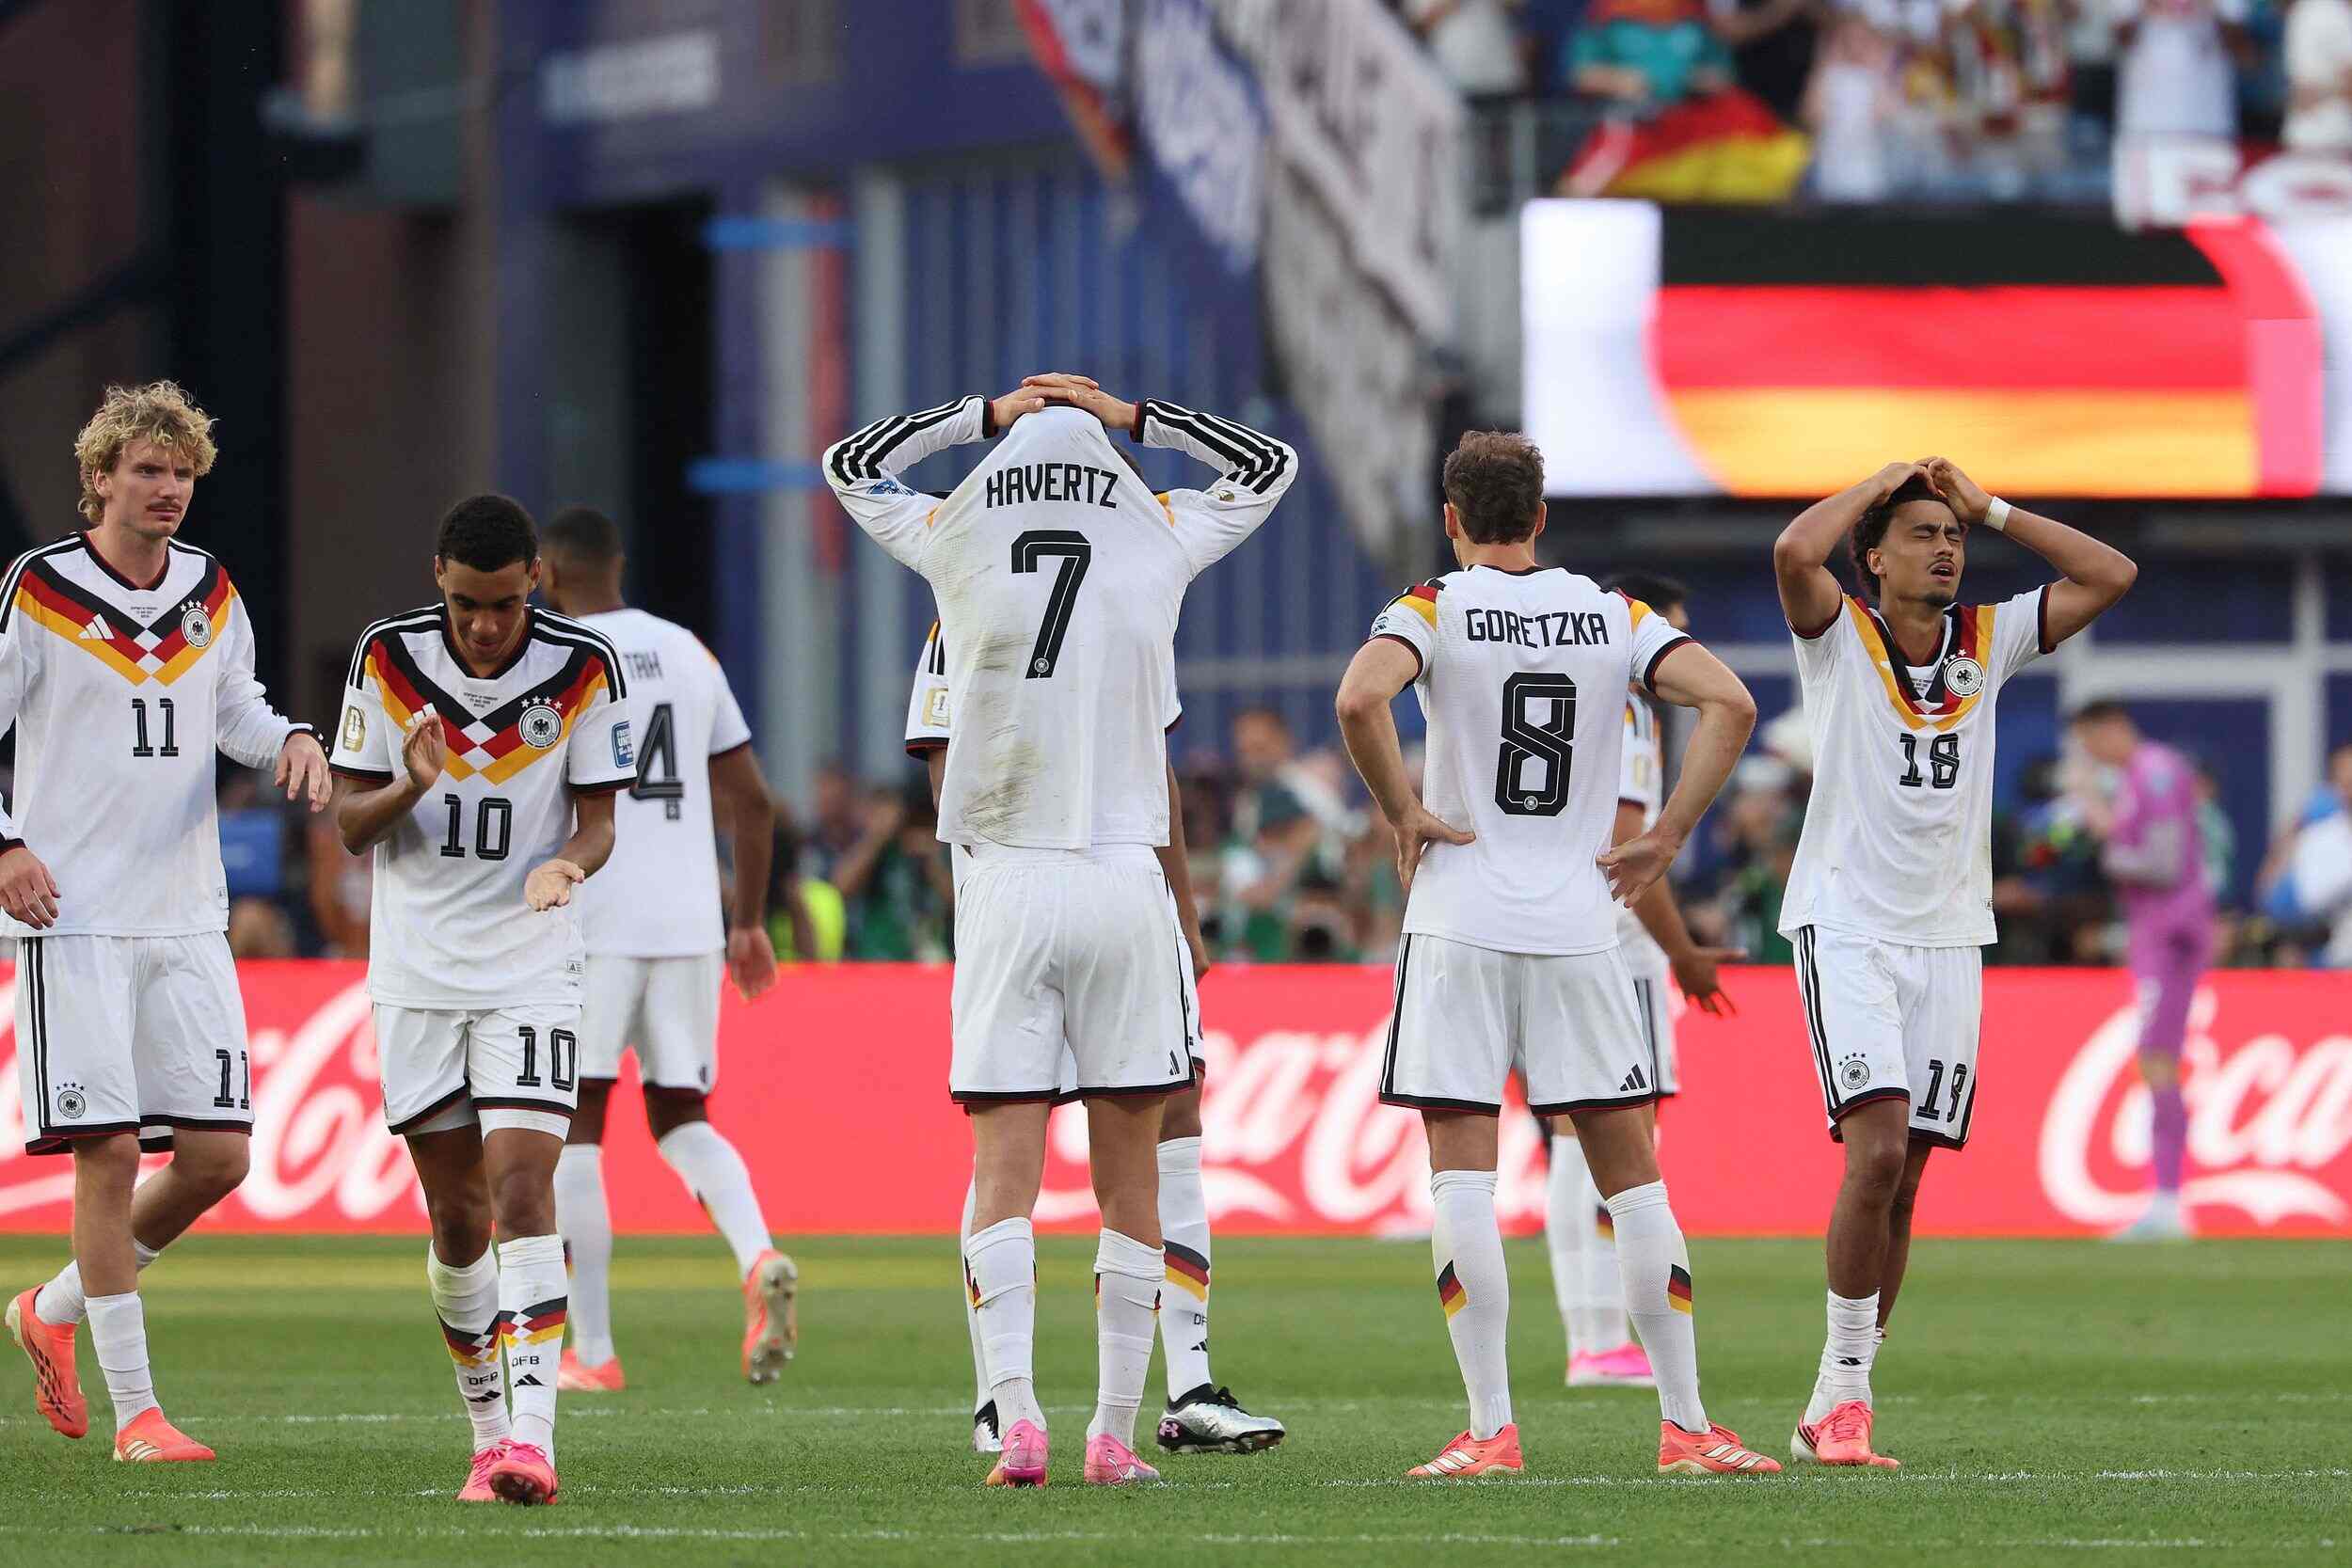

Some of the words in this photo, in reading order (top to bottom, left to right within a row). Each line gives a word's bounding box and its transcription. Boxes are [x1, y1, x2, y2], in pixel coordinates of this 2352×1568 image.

[986, 464, 1118, 509] HAVERTZ
[1010, 530, 1091, 677] 7
[1466, 609, 1609, 649] GORETZKA
[131, 696, 179, 757] 11
[1495, 672, 1577, 816] 8
[630, 703, 684, 820] 4
[1899, 733, 1960, 789] 18
[439, 794, 512, 860] 10
[214, 1049, 249, 1110] 11
[517, 1025, 576, 1091] 10
[1193, 1313, 1209, 1325] DF
[512, 1355, 540, 1367] DFB
